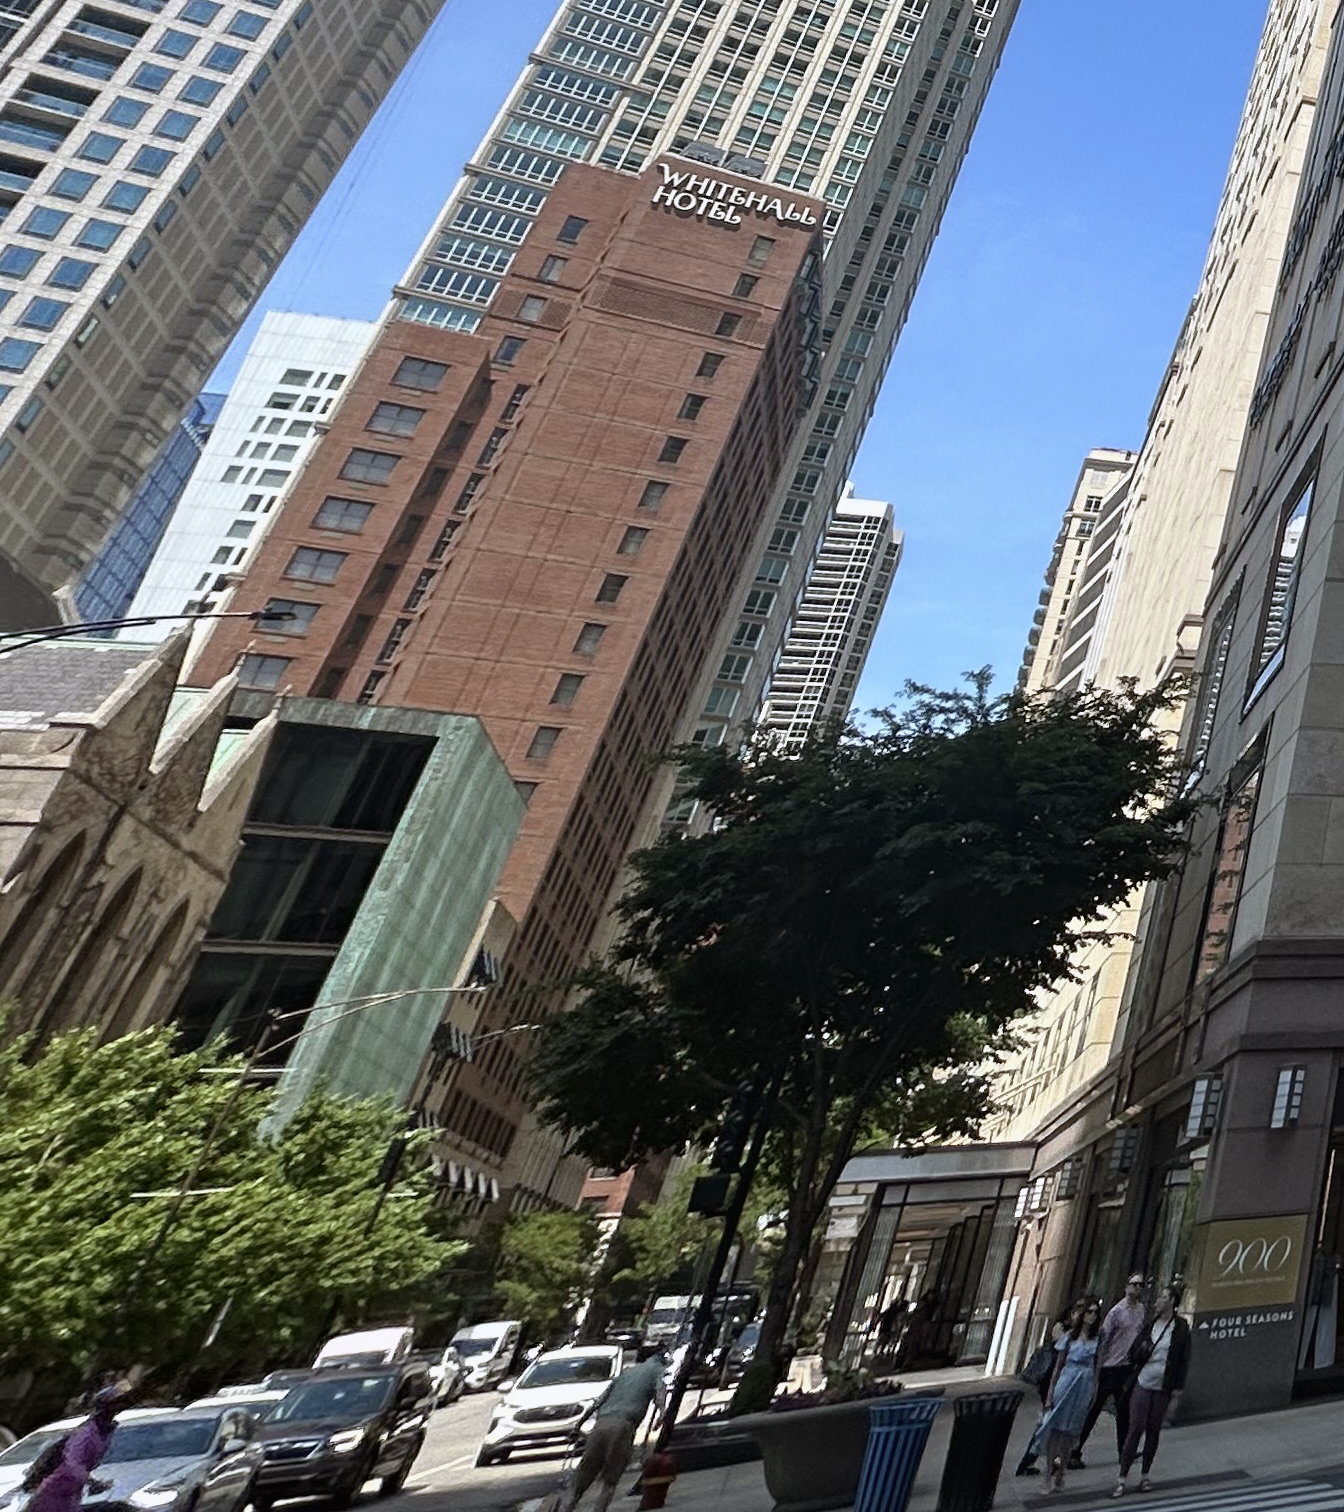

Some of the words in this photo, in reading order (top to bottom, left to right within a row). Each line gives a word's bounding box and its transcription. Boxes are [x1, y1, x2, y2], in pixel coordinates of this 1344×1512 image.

[652, 186, 742, 225] HOTEL
[657, 163, 817, 226] WHITEHALL
[1212, 1235, 1292, 1281] 900
[1209, 1328, 1246, 1339] HOTEL
[1211, 1318, 1242, 1328] FOUR
[1245, 1311, 1293, 1325] SEASONS
